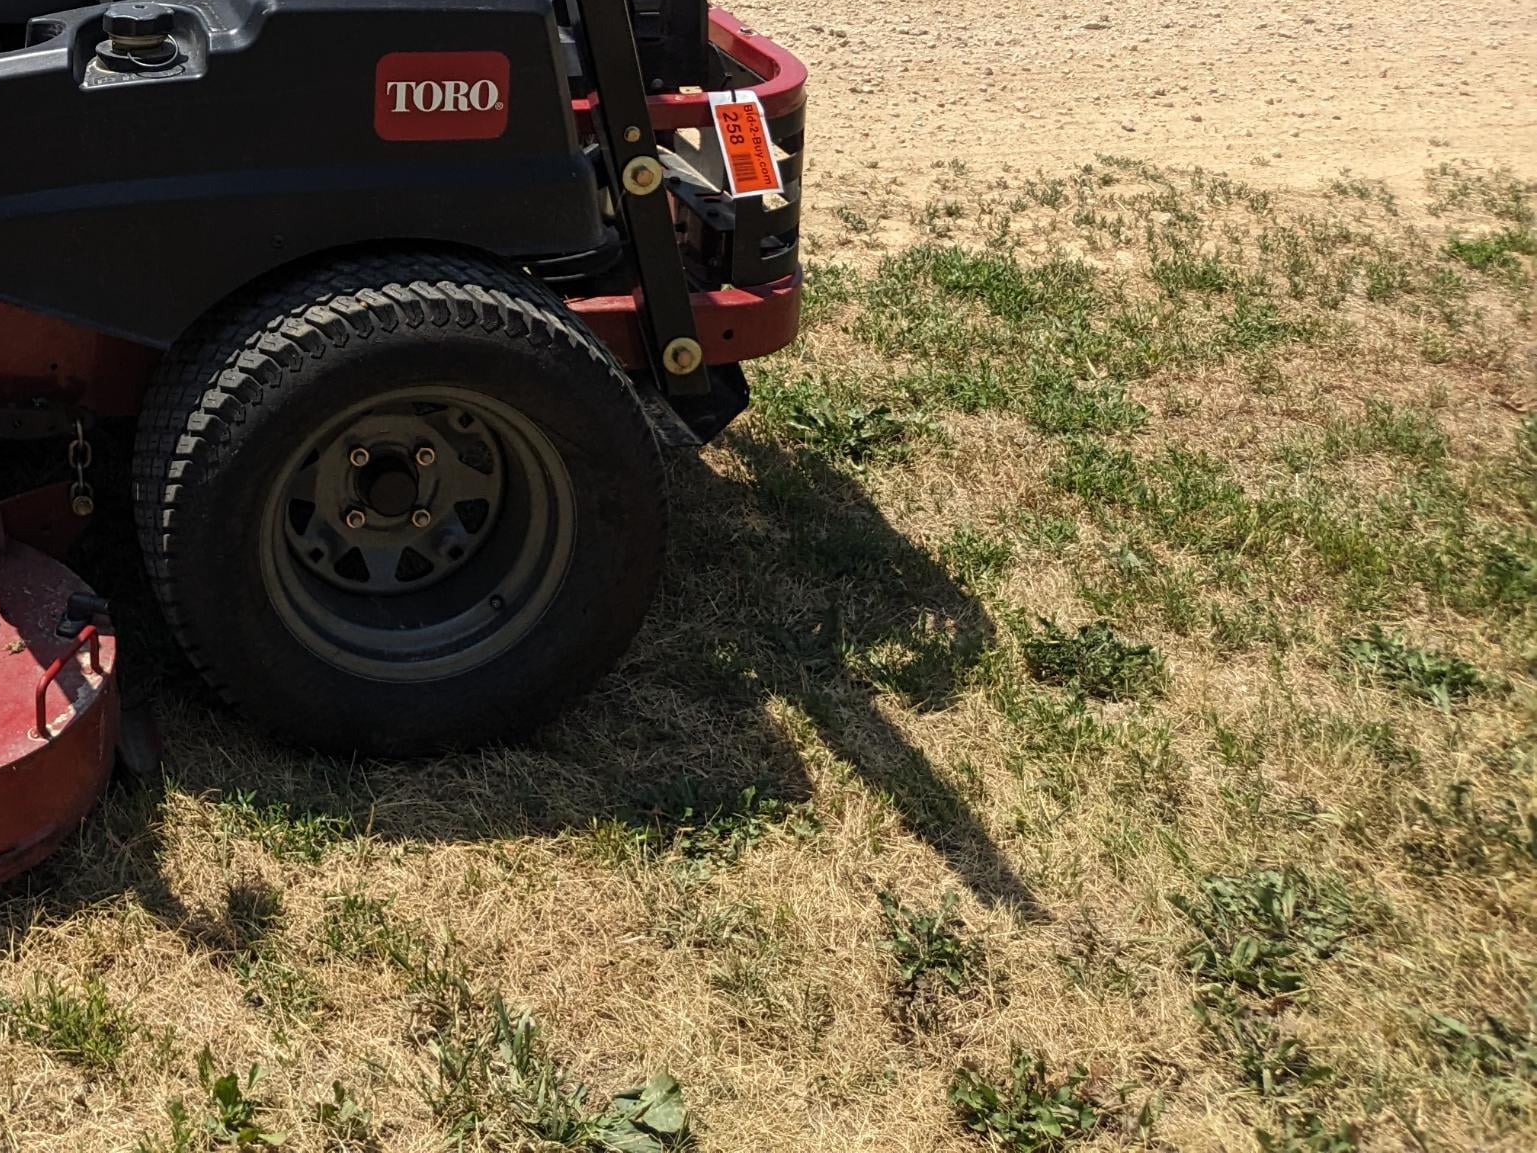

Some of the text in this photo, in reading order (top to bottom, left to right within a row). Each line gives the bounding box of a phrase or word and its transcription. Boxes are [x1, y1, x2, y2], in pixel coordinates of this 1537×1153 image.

[386, 79, 500, 113] TORO
[723, 111, 745, 145] 258
[744, 104, 772, 185] Bid-2-Buy.com
